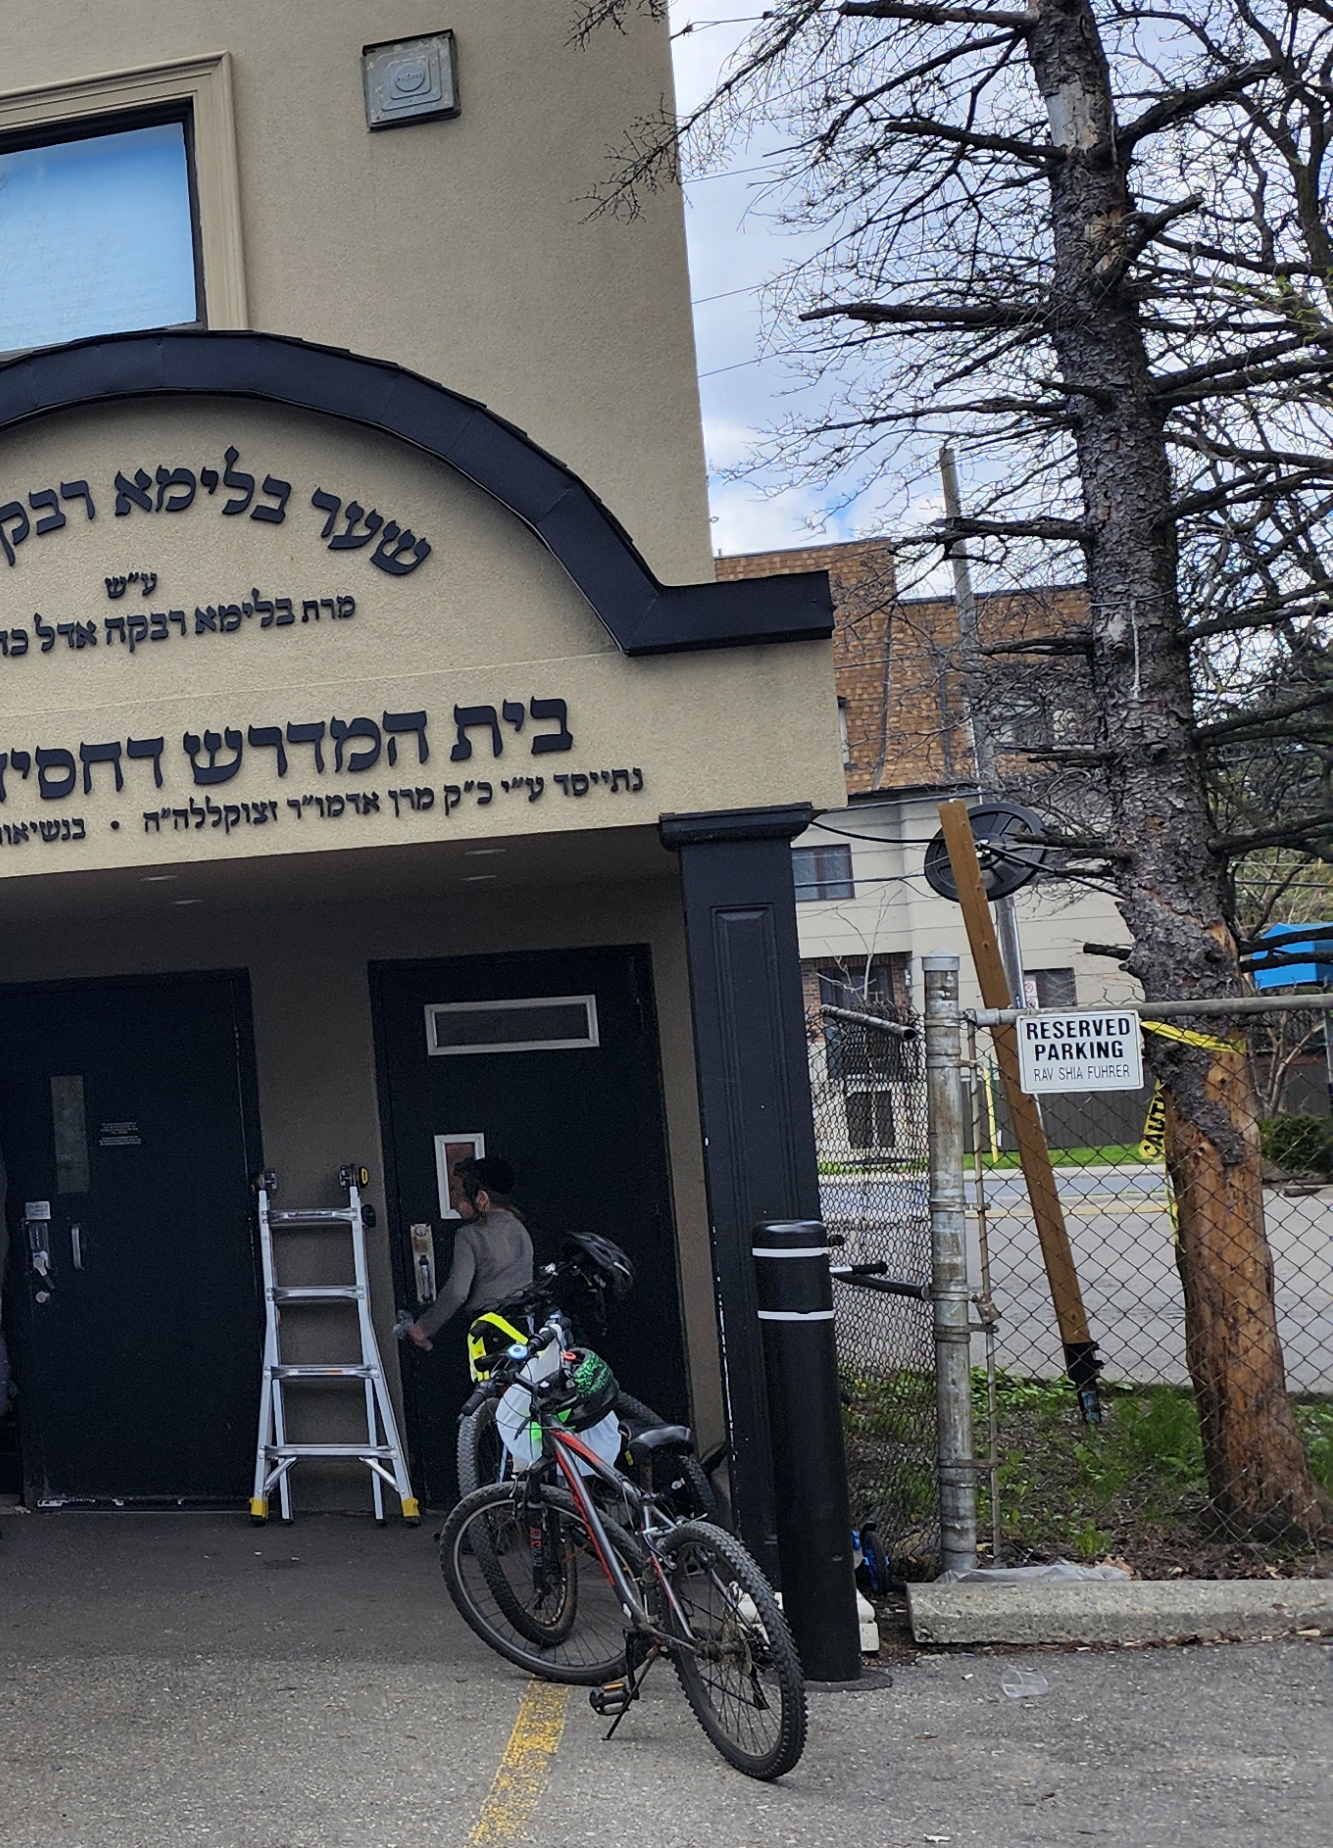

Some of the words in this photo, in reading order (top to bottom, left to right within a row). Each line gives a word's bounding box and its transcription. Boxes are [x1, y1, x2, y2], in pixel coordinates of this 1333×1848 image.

[113, 444, 293, 526] בלימא
[311, 486, 432, 576] שער
[194, 587, 296, 636] בלימא
[301, 595, 357, 624] מרת
[33, 612, 98, 654] אדל
[104, 609, 187, 654] רבקה
[183, 711, 429, 786] המדרש
[449, 695, 574, 763] בית
[387, 786, 435, 818] מרן
[553, 767, 644, 798] נתייסד
[1026, 1018, 1131, 1040] RESERVED
[1034, 1040, 1124, 1061] PARKING
[1034, 1068, 1054, 1082] RAV
[1058, 1066, 1084, 1081] SHIA
[1088, 1064, 1131, 1080] FUHRER
